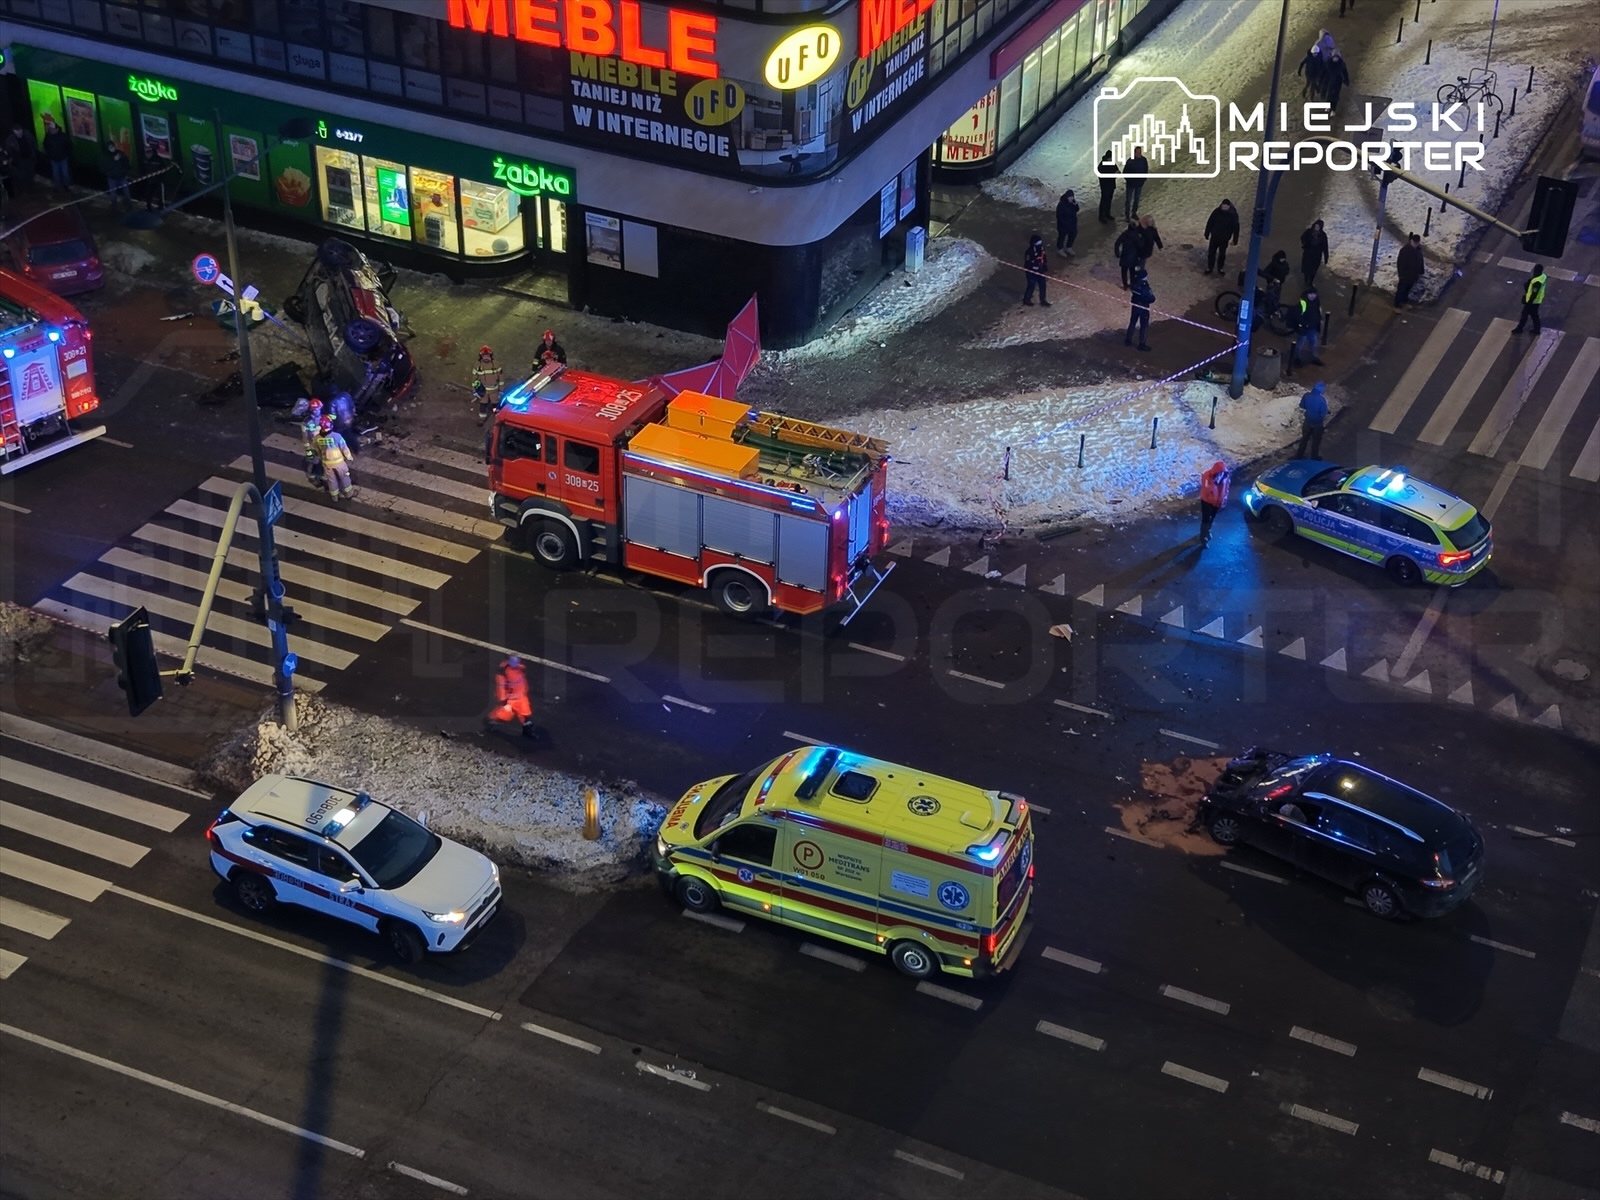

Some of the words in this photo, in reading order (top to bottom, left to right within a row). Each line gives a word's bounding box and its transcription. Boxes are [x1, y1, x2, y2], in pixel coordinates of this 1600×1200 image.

[777, 33, 830, 84] UFO
[885, 44, 911, 79] TANIEJ
[911, 30, 925, 57] NIŻ
[128, 74, 178, 102] żabka
[570, 51, 678, 96] MEBLE
[571, 79, 628, 107] TANIEJ
[631, 93, 662, 114] NIŻ
[693, 84, 737, 121] UFO
[852, 108, 863, 134] W
[864, 57, 925, 125] INTERNECIE
[572, 105, 592, 128] W
[597, 110, 730, 157] INTERNECIE
[493, 157, 570, 196] żabka
[1303, 511, 1336, 530] POLICJA
[803, 847, 814, 861] P
[828, 856, 871, 874] MEDITRANS
[793, 866, 809, 877] W01
[810, 870, 826, 881] 050
